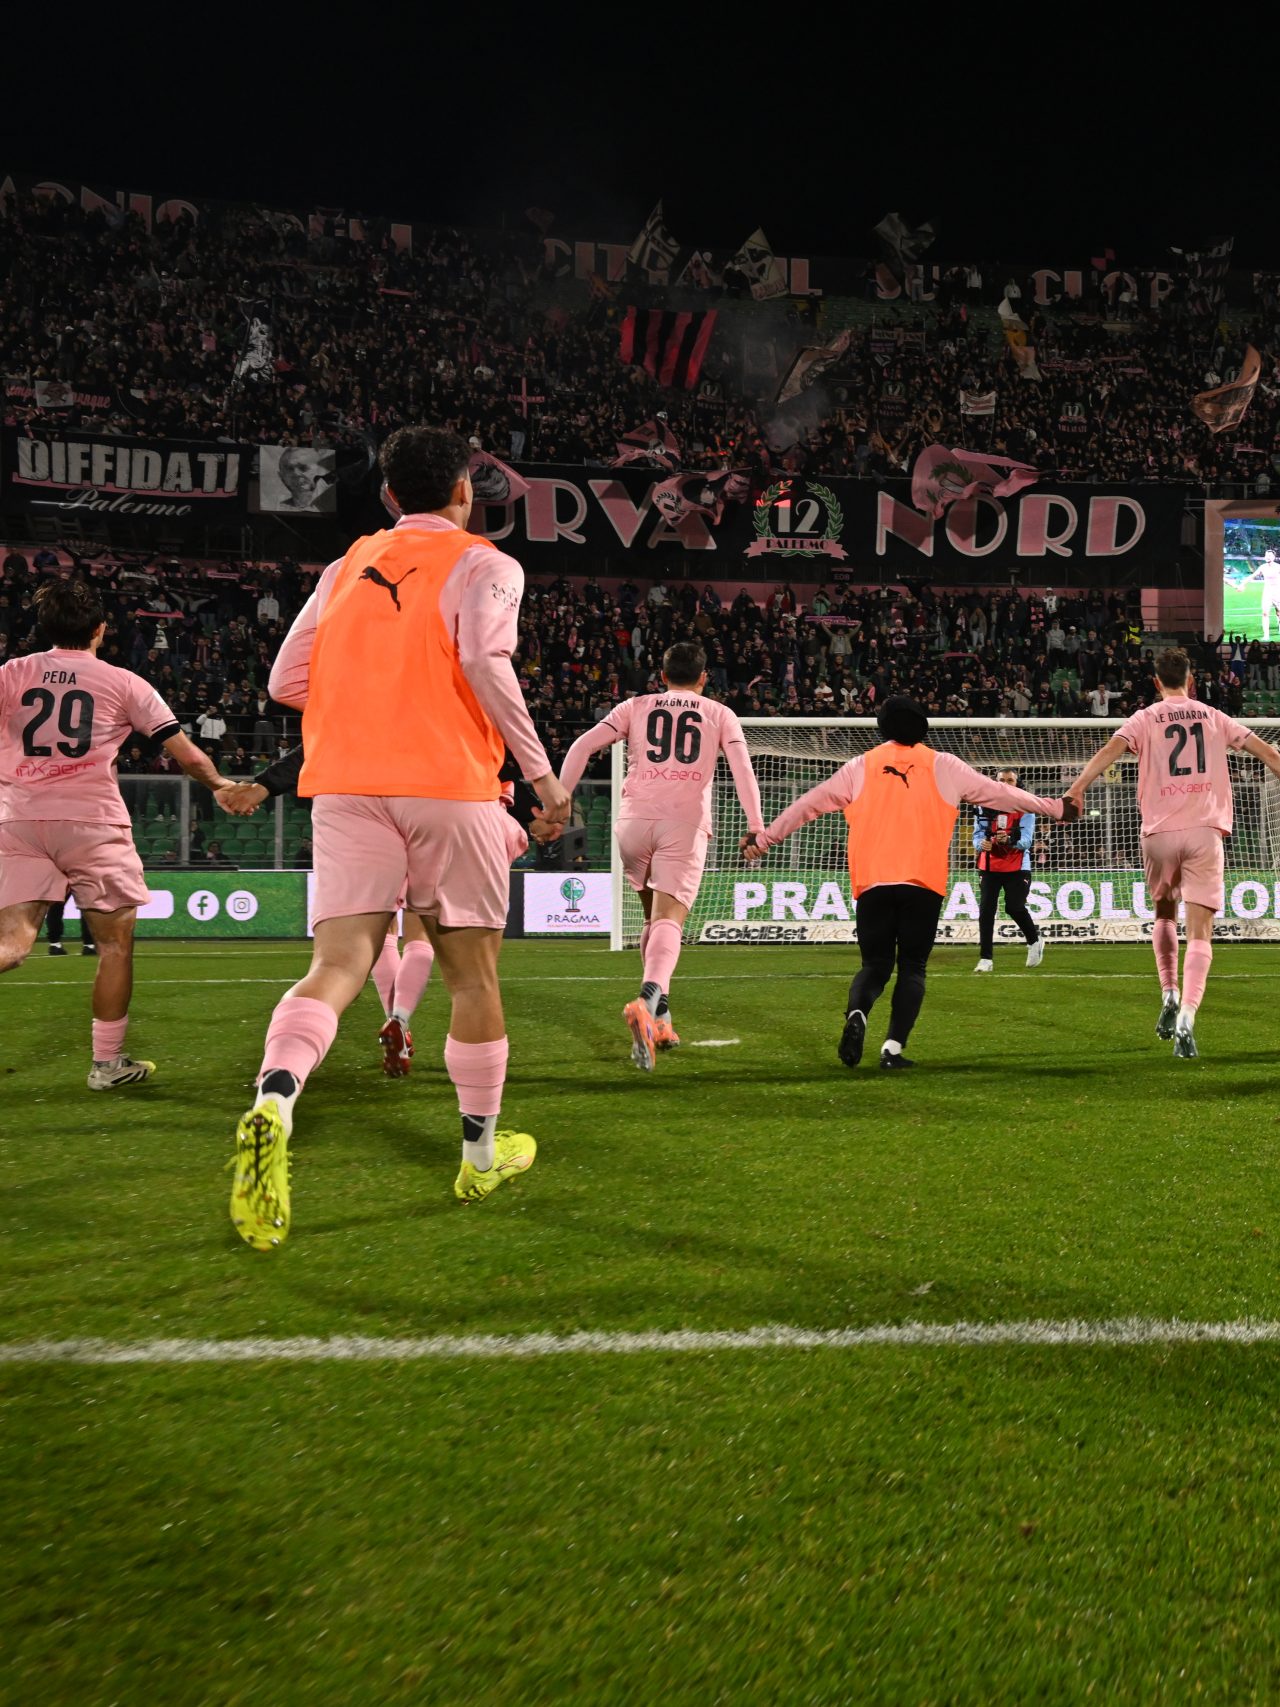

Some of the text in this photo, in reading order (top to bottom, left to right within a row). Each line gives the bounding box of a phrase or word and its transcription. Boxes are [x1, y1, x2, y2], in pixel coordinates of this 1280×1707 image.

[17, 436, 241, 494] DIFFIDATI
[60, 486, 192, 517] Palermo
[773, 499, 820, 533] 12
[875, 490, 1147, 558] NORD
[43, 671, 77, 685] PEDA
[655, 697, 700, 710] MAGNANI
[1168, 710, 1209, 721] DOUARON
[21, 688, 95, 758] 29
[646, 709, 702, 764] 96
[1164, 722, 1206, 777] 21
[734, 881, 981, 920] PRAA
[547, 914, 600, 923] PRAGMA
[704, 924, 808, 940] GoldBet
